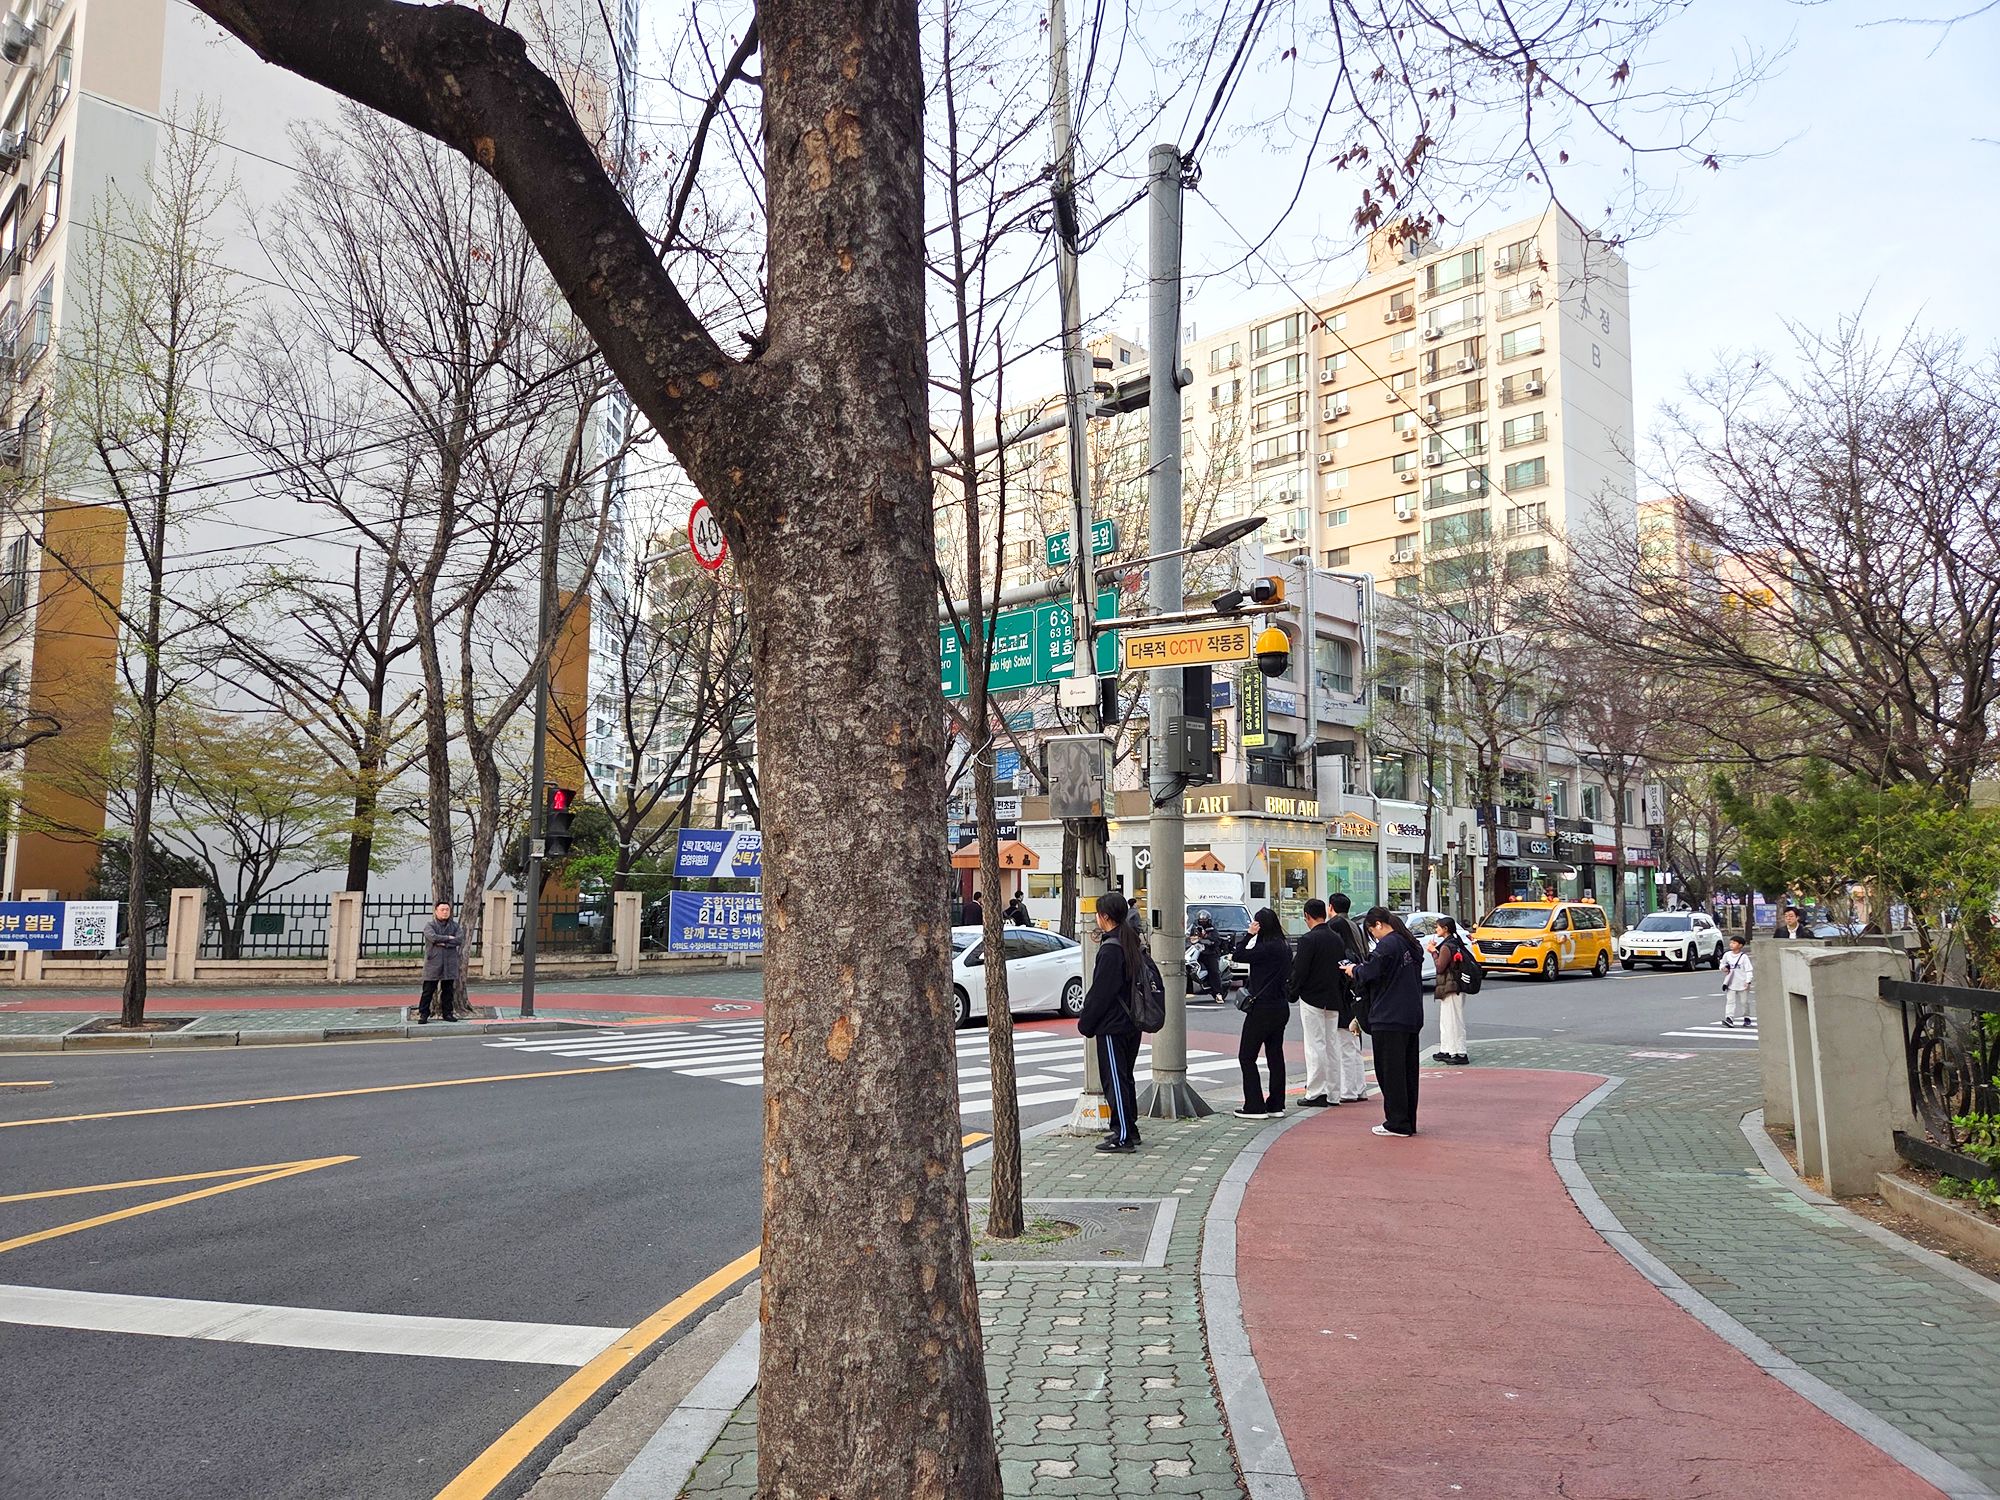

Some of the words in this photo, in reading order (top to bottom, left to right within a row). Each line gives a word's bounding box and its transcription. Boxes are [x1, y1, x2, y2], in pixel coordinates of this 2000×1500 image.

[697, 516, 719, 548] 40
[1050, 627, 1061, 638] 63
[1131, 641, 1166, 659] 다목적
[1169, 638, 1203, 656] CCTV
[1207, 633, 1245, 653] 작동중
[1001, 657, 1012, 673] High
[1013, 653, 1032, 668] School
[1198, 795, 1232, 813] ART
[1265, 795, 1297, 815] BROT
[1297, 799, 1320, 817] ART
[960, 827, 976, 837] WILL
[737, 835, 763, 850] 공공
[1530, 840, 1548, 854] GS25
[732, 851, 755, 866] 신탁
[24, 914, 56, 932] 열람
[683, 926, 705, 940] 함께
[707, 927, 728, 939] 모은
[731, 927, 764, 940] 동의서
